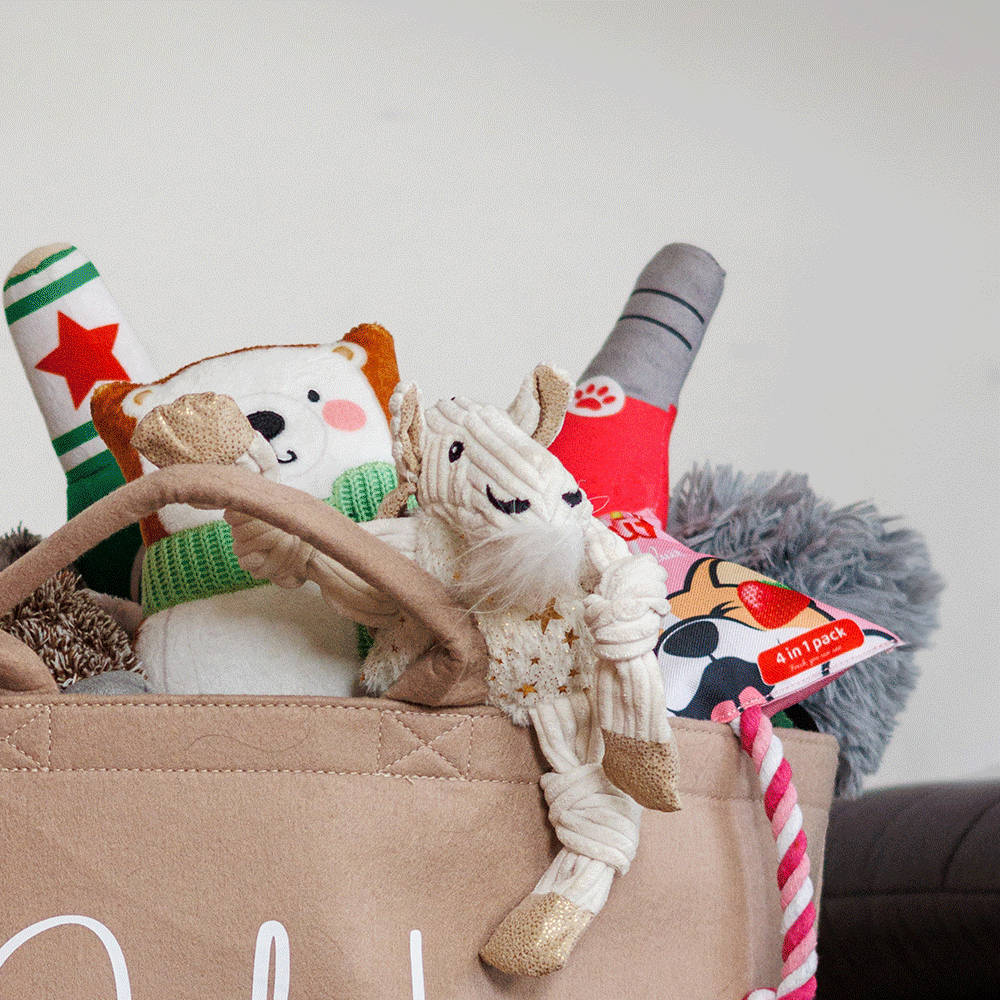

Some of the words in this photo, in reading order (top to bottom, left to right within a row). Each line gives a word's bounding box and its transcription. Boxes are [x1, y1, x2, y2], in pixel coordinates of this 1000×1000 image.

[776, 652, 786, 664] 4
[785, 646, 802, 660] in
[802, 640, 811, 652] 1
[812, 626, 847, 652] pack
